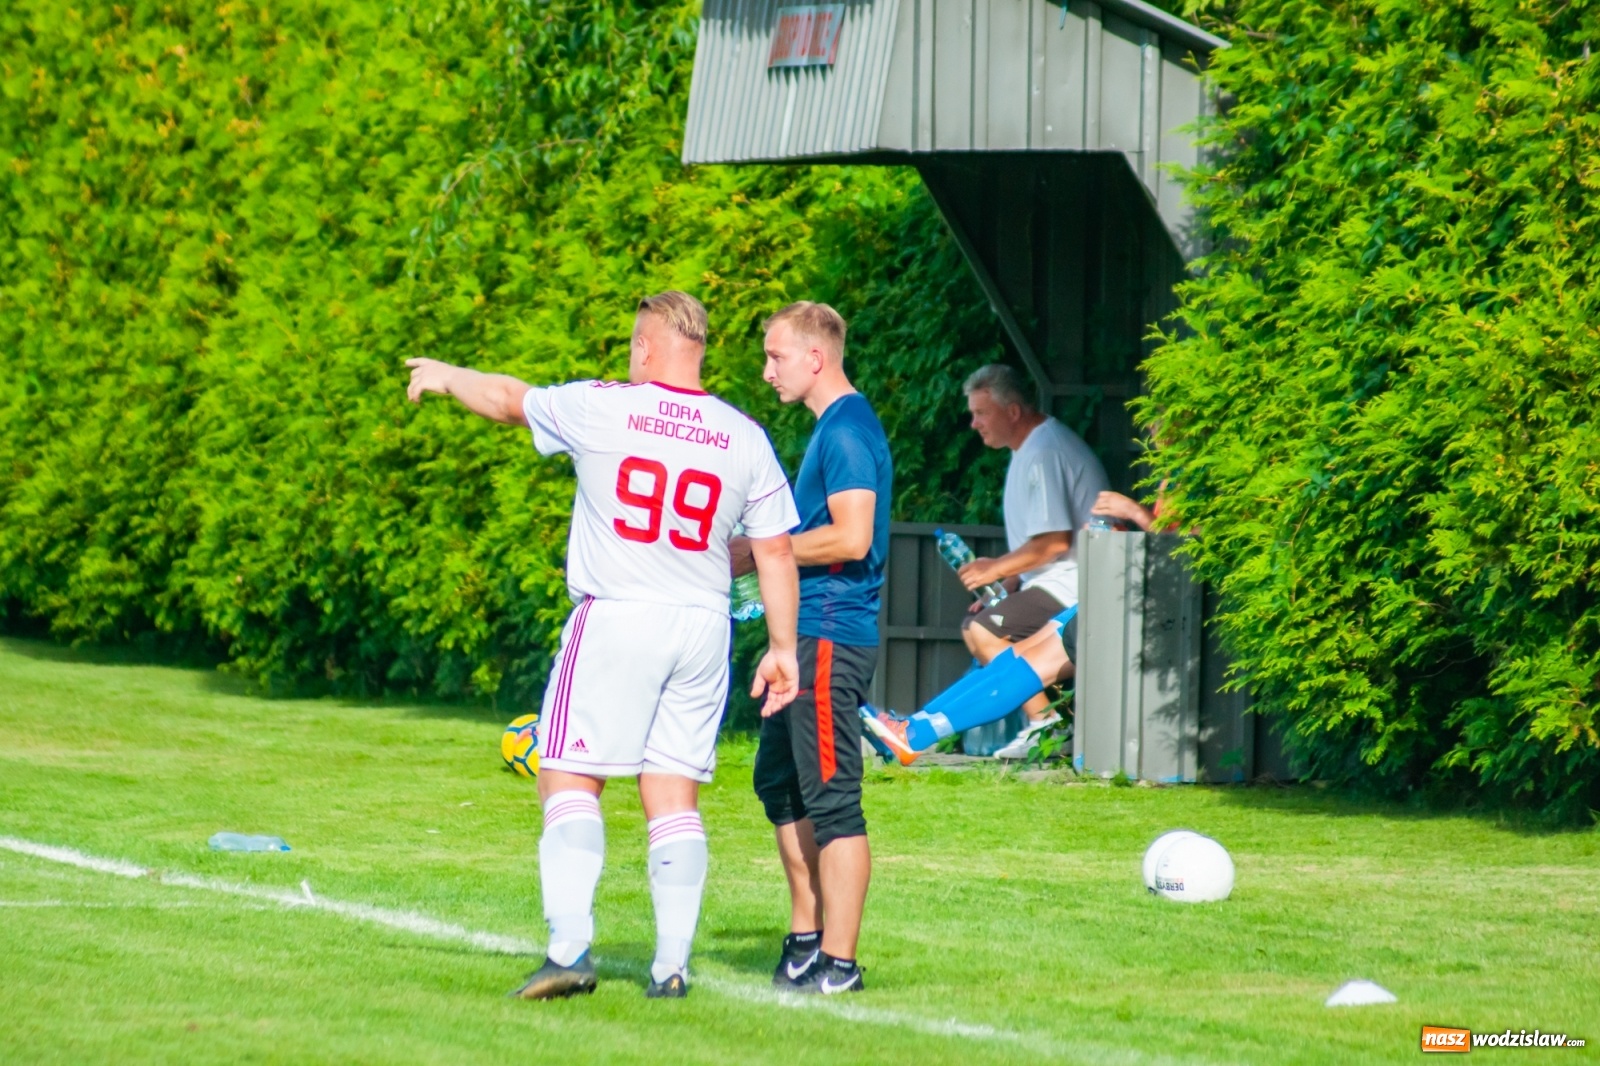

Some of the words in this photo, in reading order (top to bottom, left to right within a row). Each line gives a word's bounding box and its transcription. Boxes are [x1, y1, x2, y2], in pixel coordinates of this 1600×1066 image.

[658, 401, 703, 424] ODRA
[627, 414, 730, 450] NIEBOCZOWY
[613, 456, 723, 552] 99
